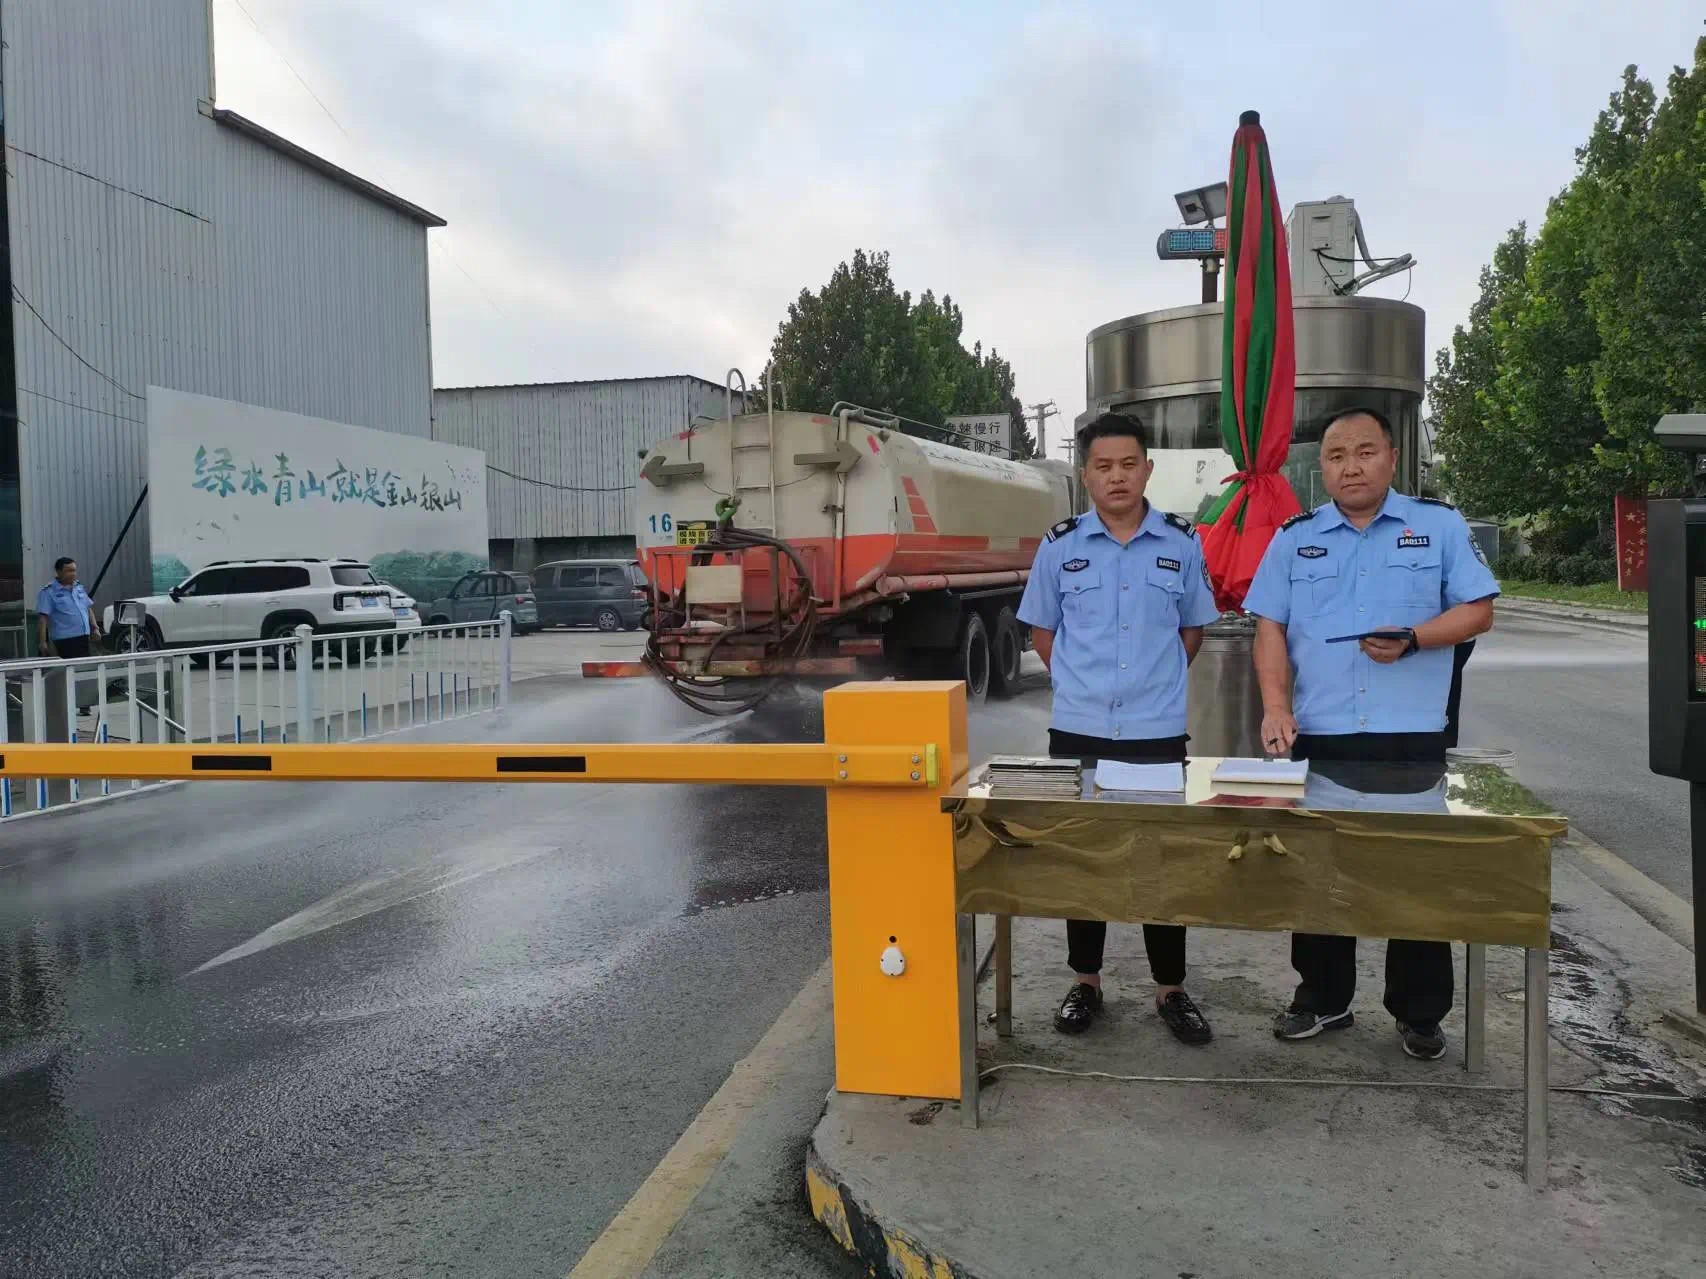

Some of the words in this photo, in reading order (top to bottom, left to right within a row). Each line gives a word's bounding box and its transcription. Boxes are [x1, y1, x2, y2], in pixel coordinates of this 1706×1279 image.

[191, 444, 462, 512] 绿水青山就是金山银山
[648, 512, 672, 533] 16
